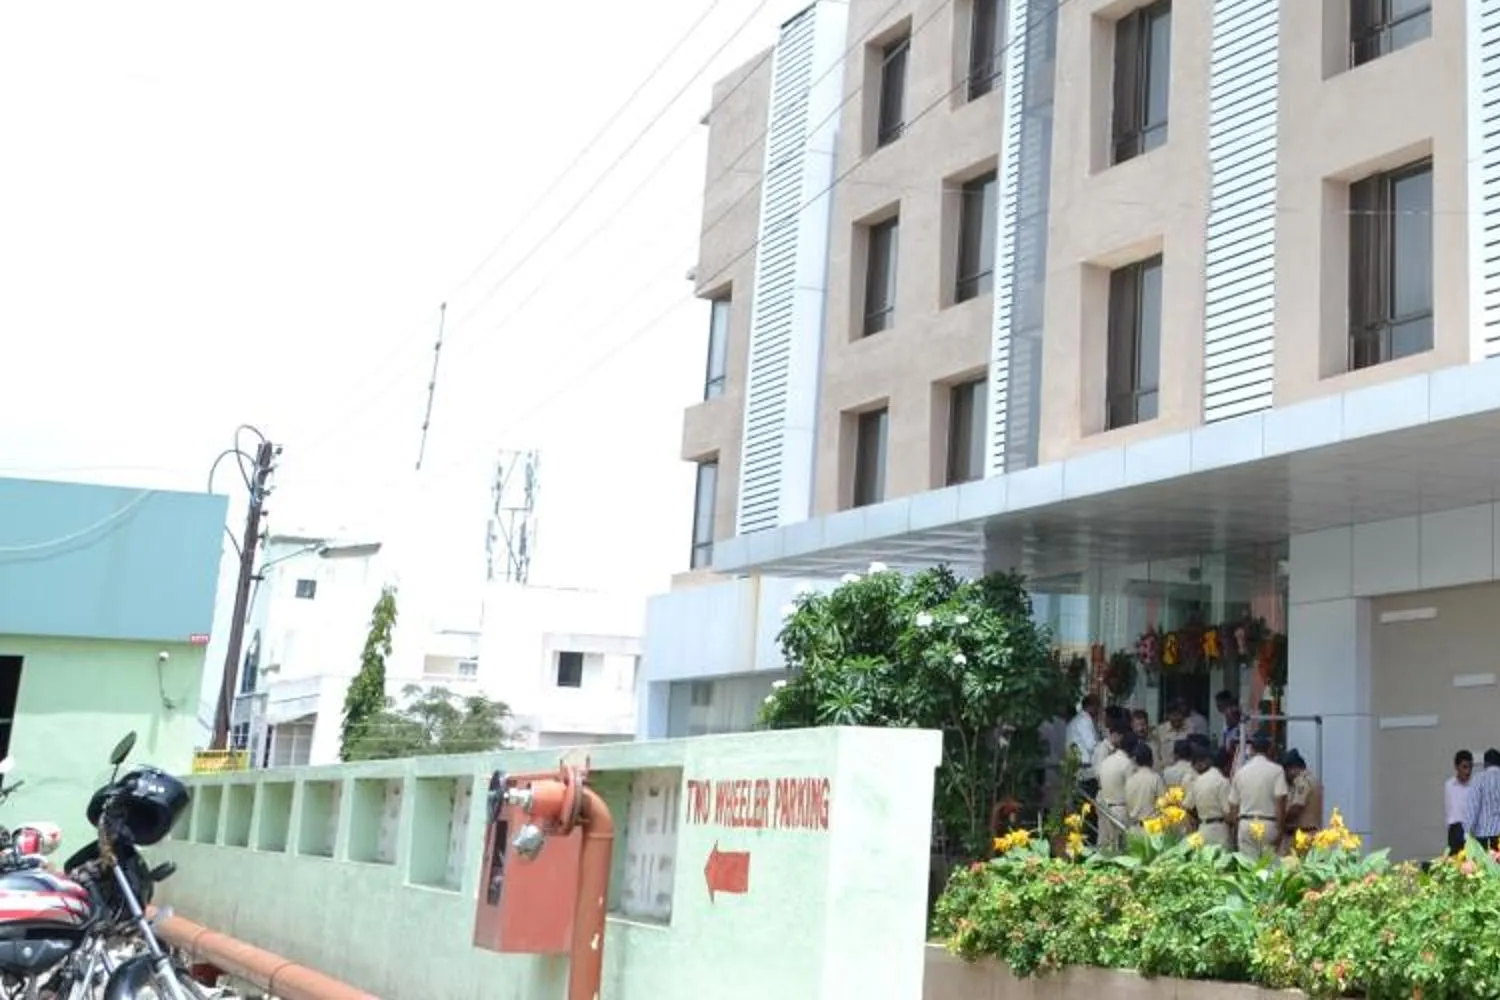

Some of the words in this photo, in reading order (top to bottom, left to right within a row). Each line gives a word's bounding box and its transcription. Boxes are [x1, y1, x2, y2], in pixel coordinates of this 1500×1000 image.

[686, 779, 711, 825] TWO
[715, 778, 770, 828] WHEELER
[774, 776, 831, 831] PARKING
